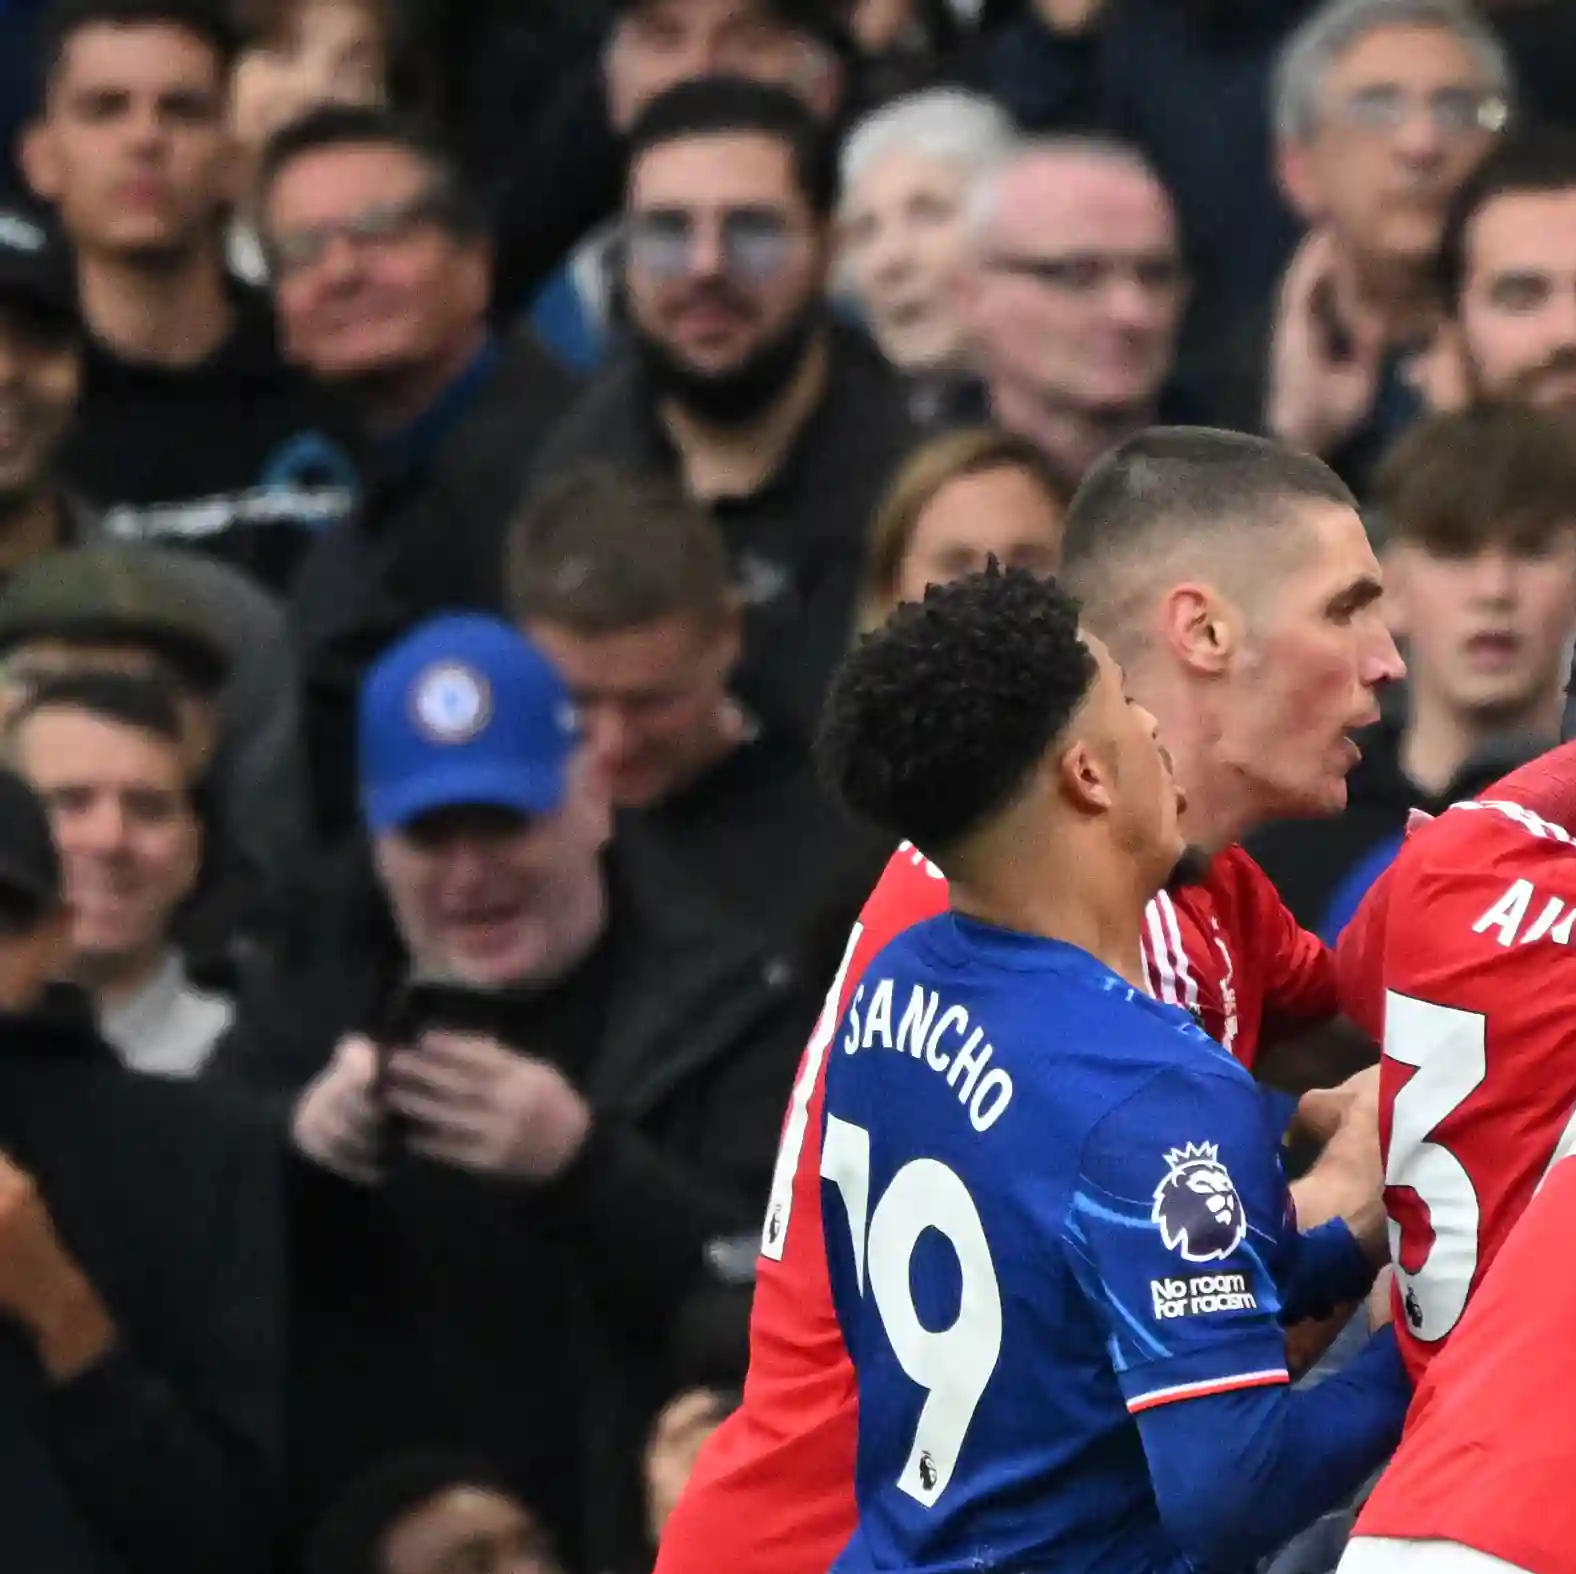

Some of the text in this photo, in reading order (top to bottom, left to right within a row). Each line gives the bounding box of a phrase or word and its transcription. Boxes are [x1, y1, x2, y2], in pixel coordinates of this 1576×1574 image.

[843, 979, 1013, 1132] SANCHO
[820, 1113, 1003, 1508] 19
[1150, 1274, 1245, 1300] No room
[1154, 1293, 1257, 1319] for racism
